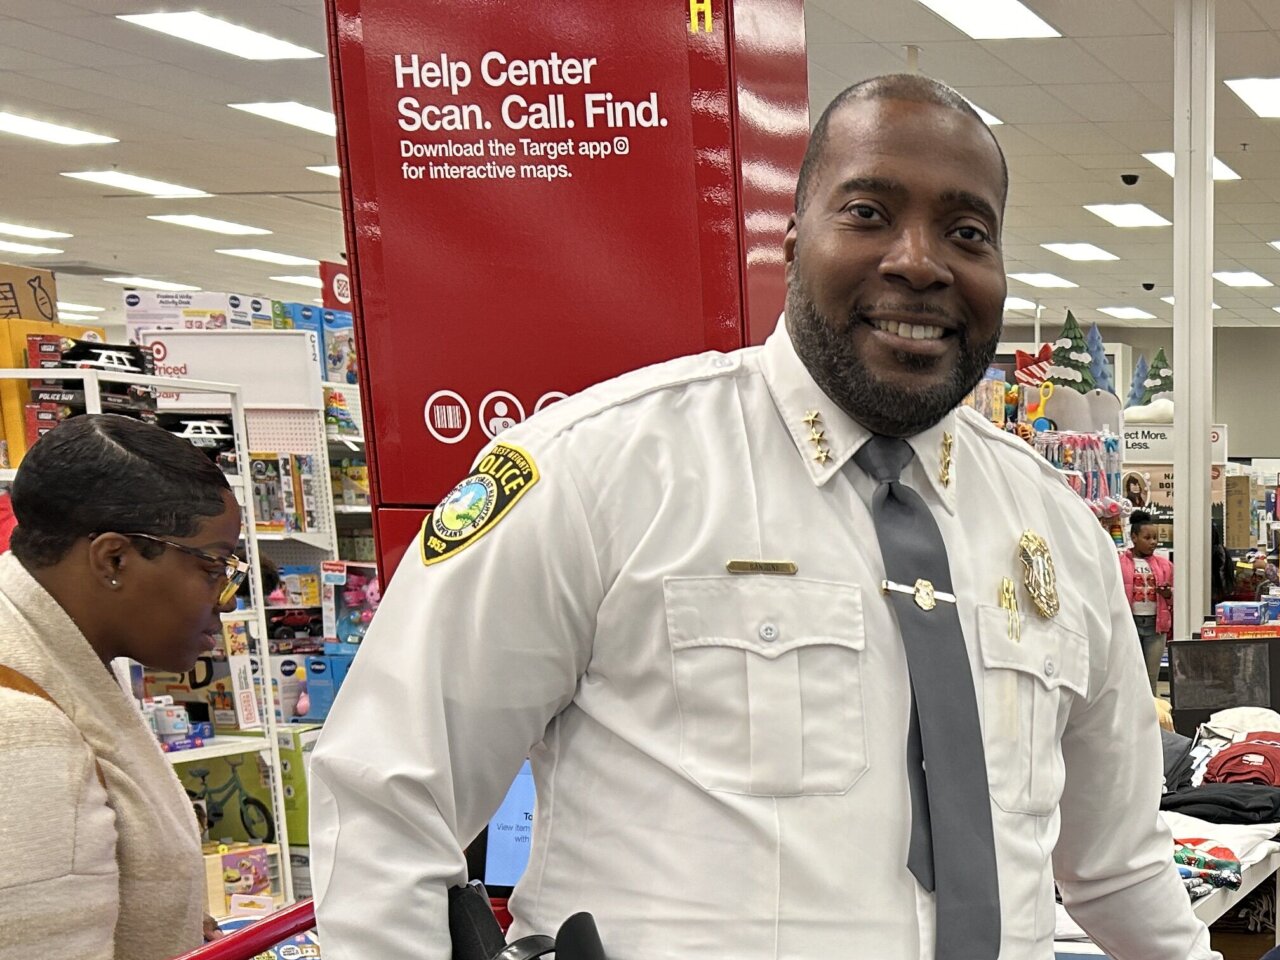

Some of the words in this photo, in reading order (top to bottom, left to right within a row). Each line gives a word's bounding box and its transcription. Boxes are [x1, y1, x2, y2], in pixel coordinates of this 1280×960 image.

[394, 53, 471, 95] Help
[480, 51, 597, 86] Center
[397, 96, 492, 132] Scan.
[501, 94, 575, 130] Call.
[585, 93, 668, 128] Find.
[400, 140, 484, 159] Download
[488, 139, 516, 156] the
[519, 138, 575, 159] Target
[578, 142, 612, 160] app
[402, 162, 426, 180] for
[429, 161, 516, 179] interactive
[520, 164, 573, 182] maps.
[153, 363, 187, 375] Priced
[38, 392, 62, 401] POLICE
[1124, 432, 1140, 440] ect
[1141, 431, 1168, 440] More.
[1125, 441, 1150, 450] Less.
[478, 454, 525, 496] OLICE
[427, 536, 447, 553] 1952
[497, 823, 514, 832] View
[515, 835, 530, 843] with
